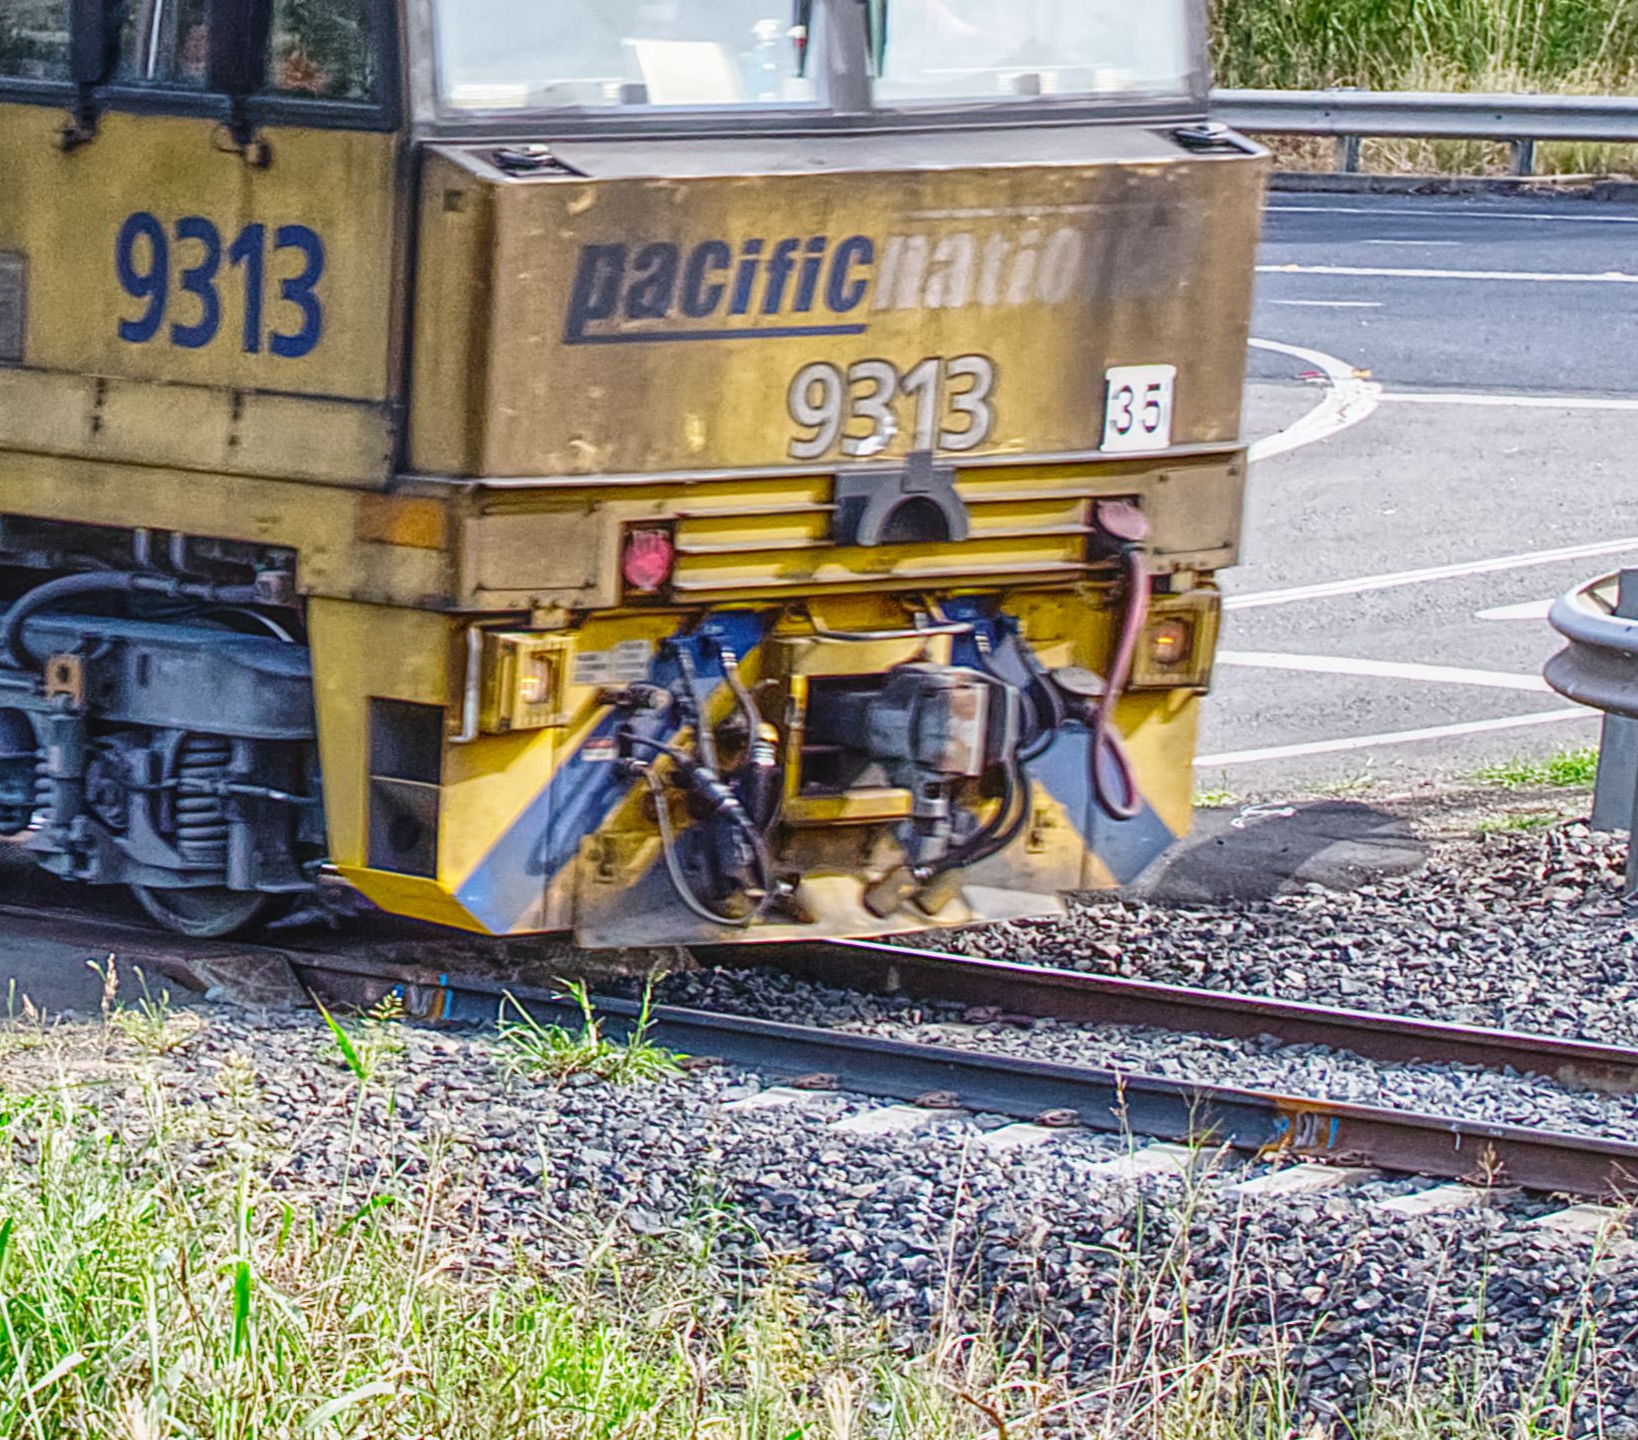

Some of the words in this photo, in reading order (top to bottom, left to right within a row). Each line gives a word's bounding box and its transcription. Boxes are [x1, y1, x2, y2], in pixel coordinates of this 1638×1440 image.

[114, 211, 324, 359] 9313
[563, 234, 874, 345] pacific
[786, 353, 997, 460] 9313
[1110, 383, 1163, 436] 35
